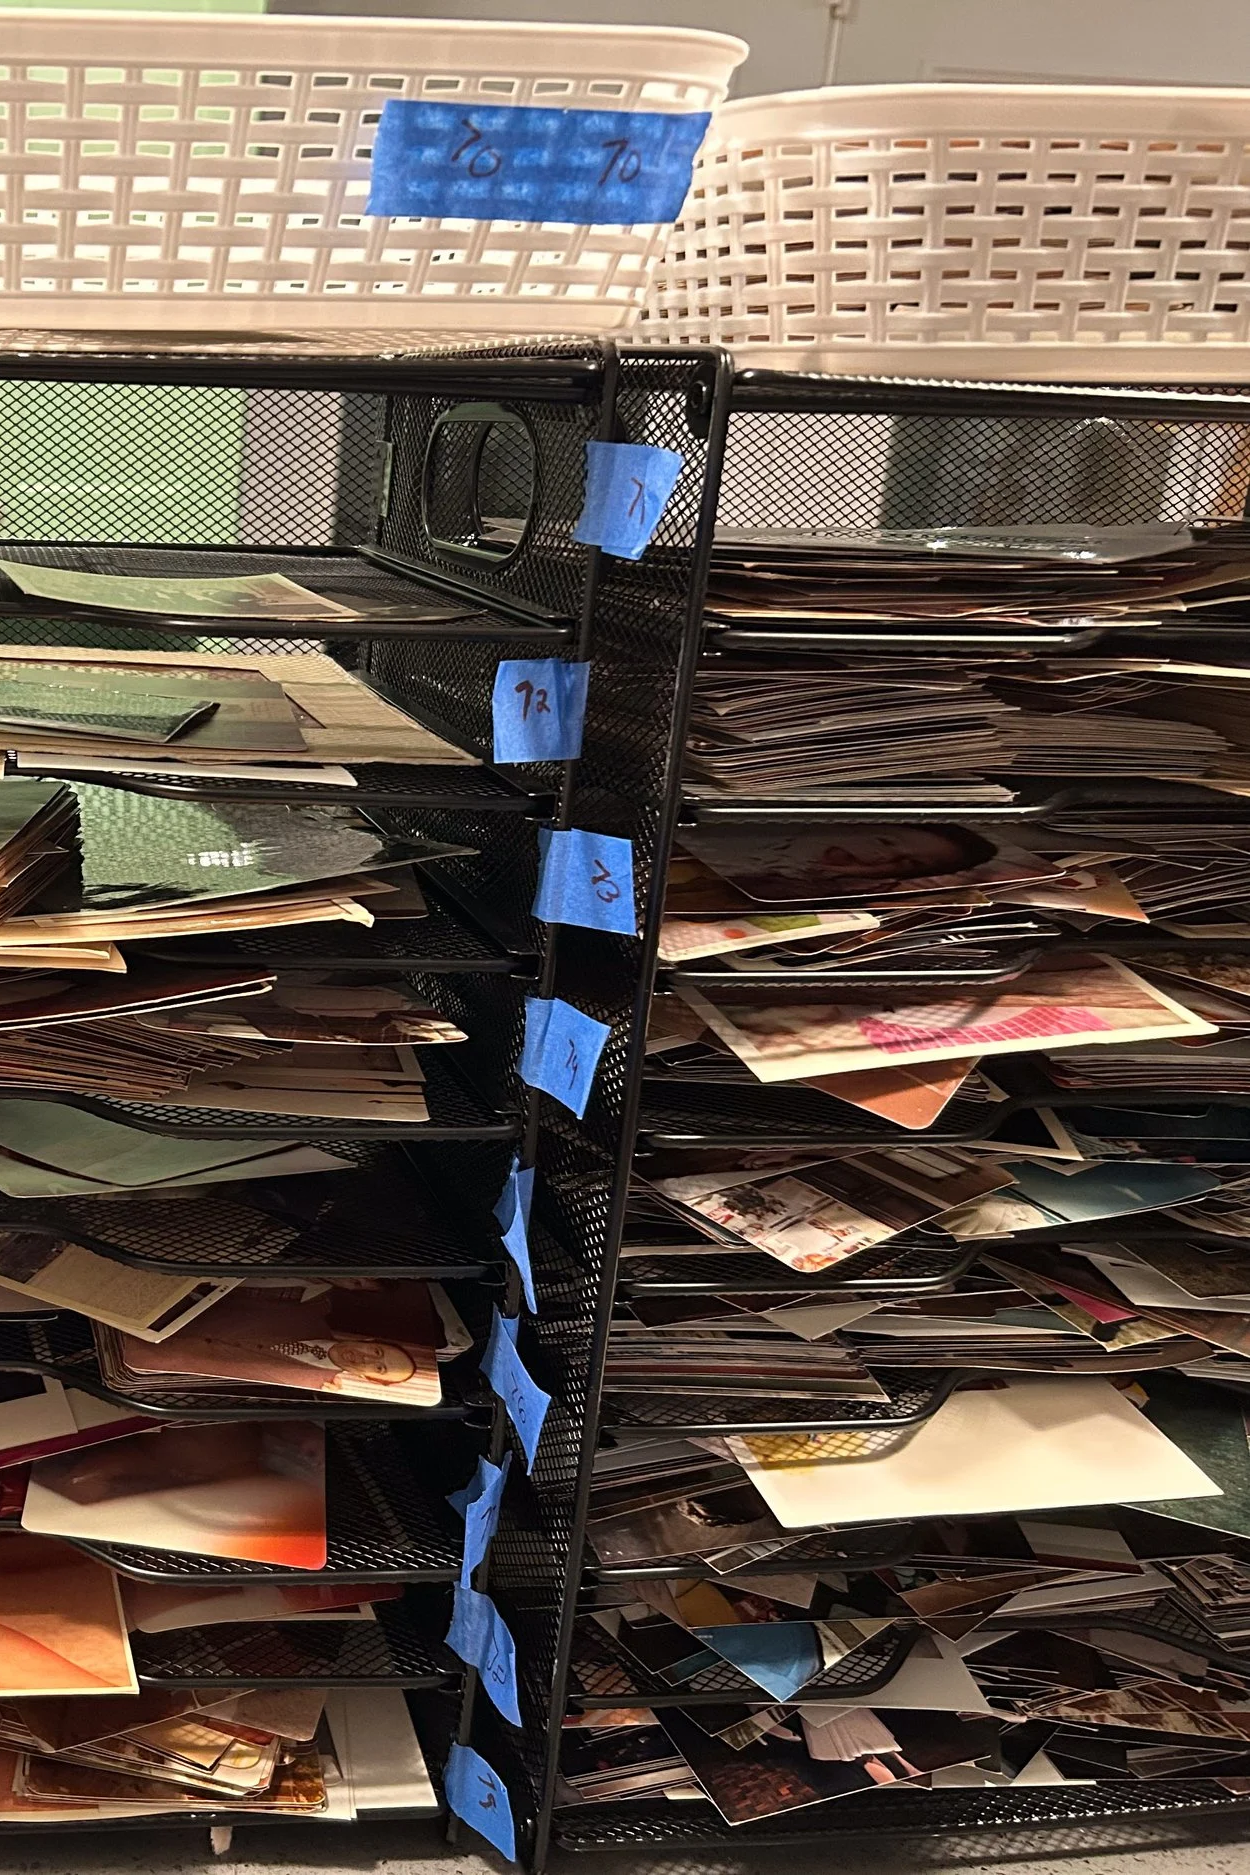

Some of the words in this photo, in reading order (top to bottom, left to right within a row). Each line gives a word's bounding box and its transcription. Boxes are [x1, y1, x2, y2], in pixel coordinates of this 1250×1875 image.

[451, 118, 502, 178] 70
[598, 137, 641, 186] 70
[514, 680, 550, 722] 72
